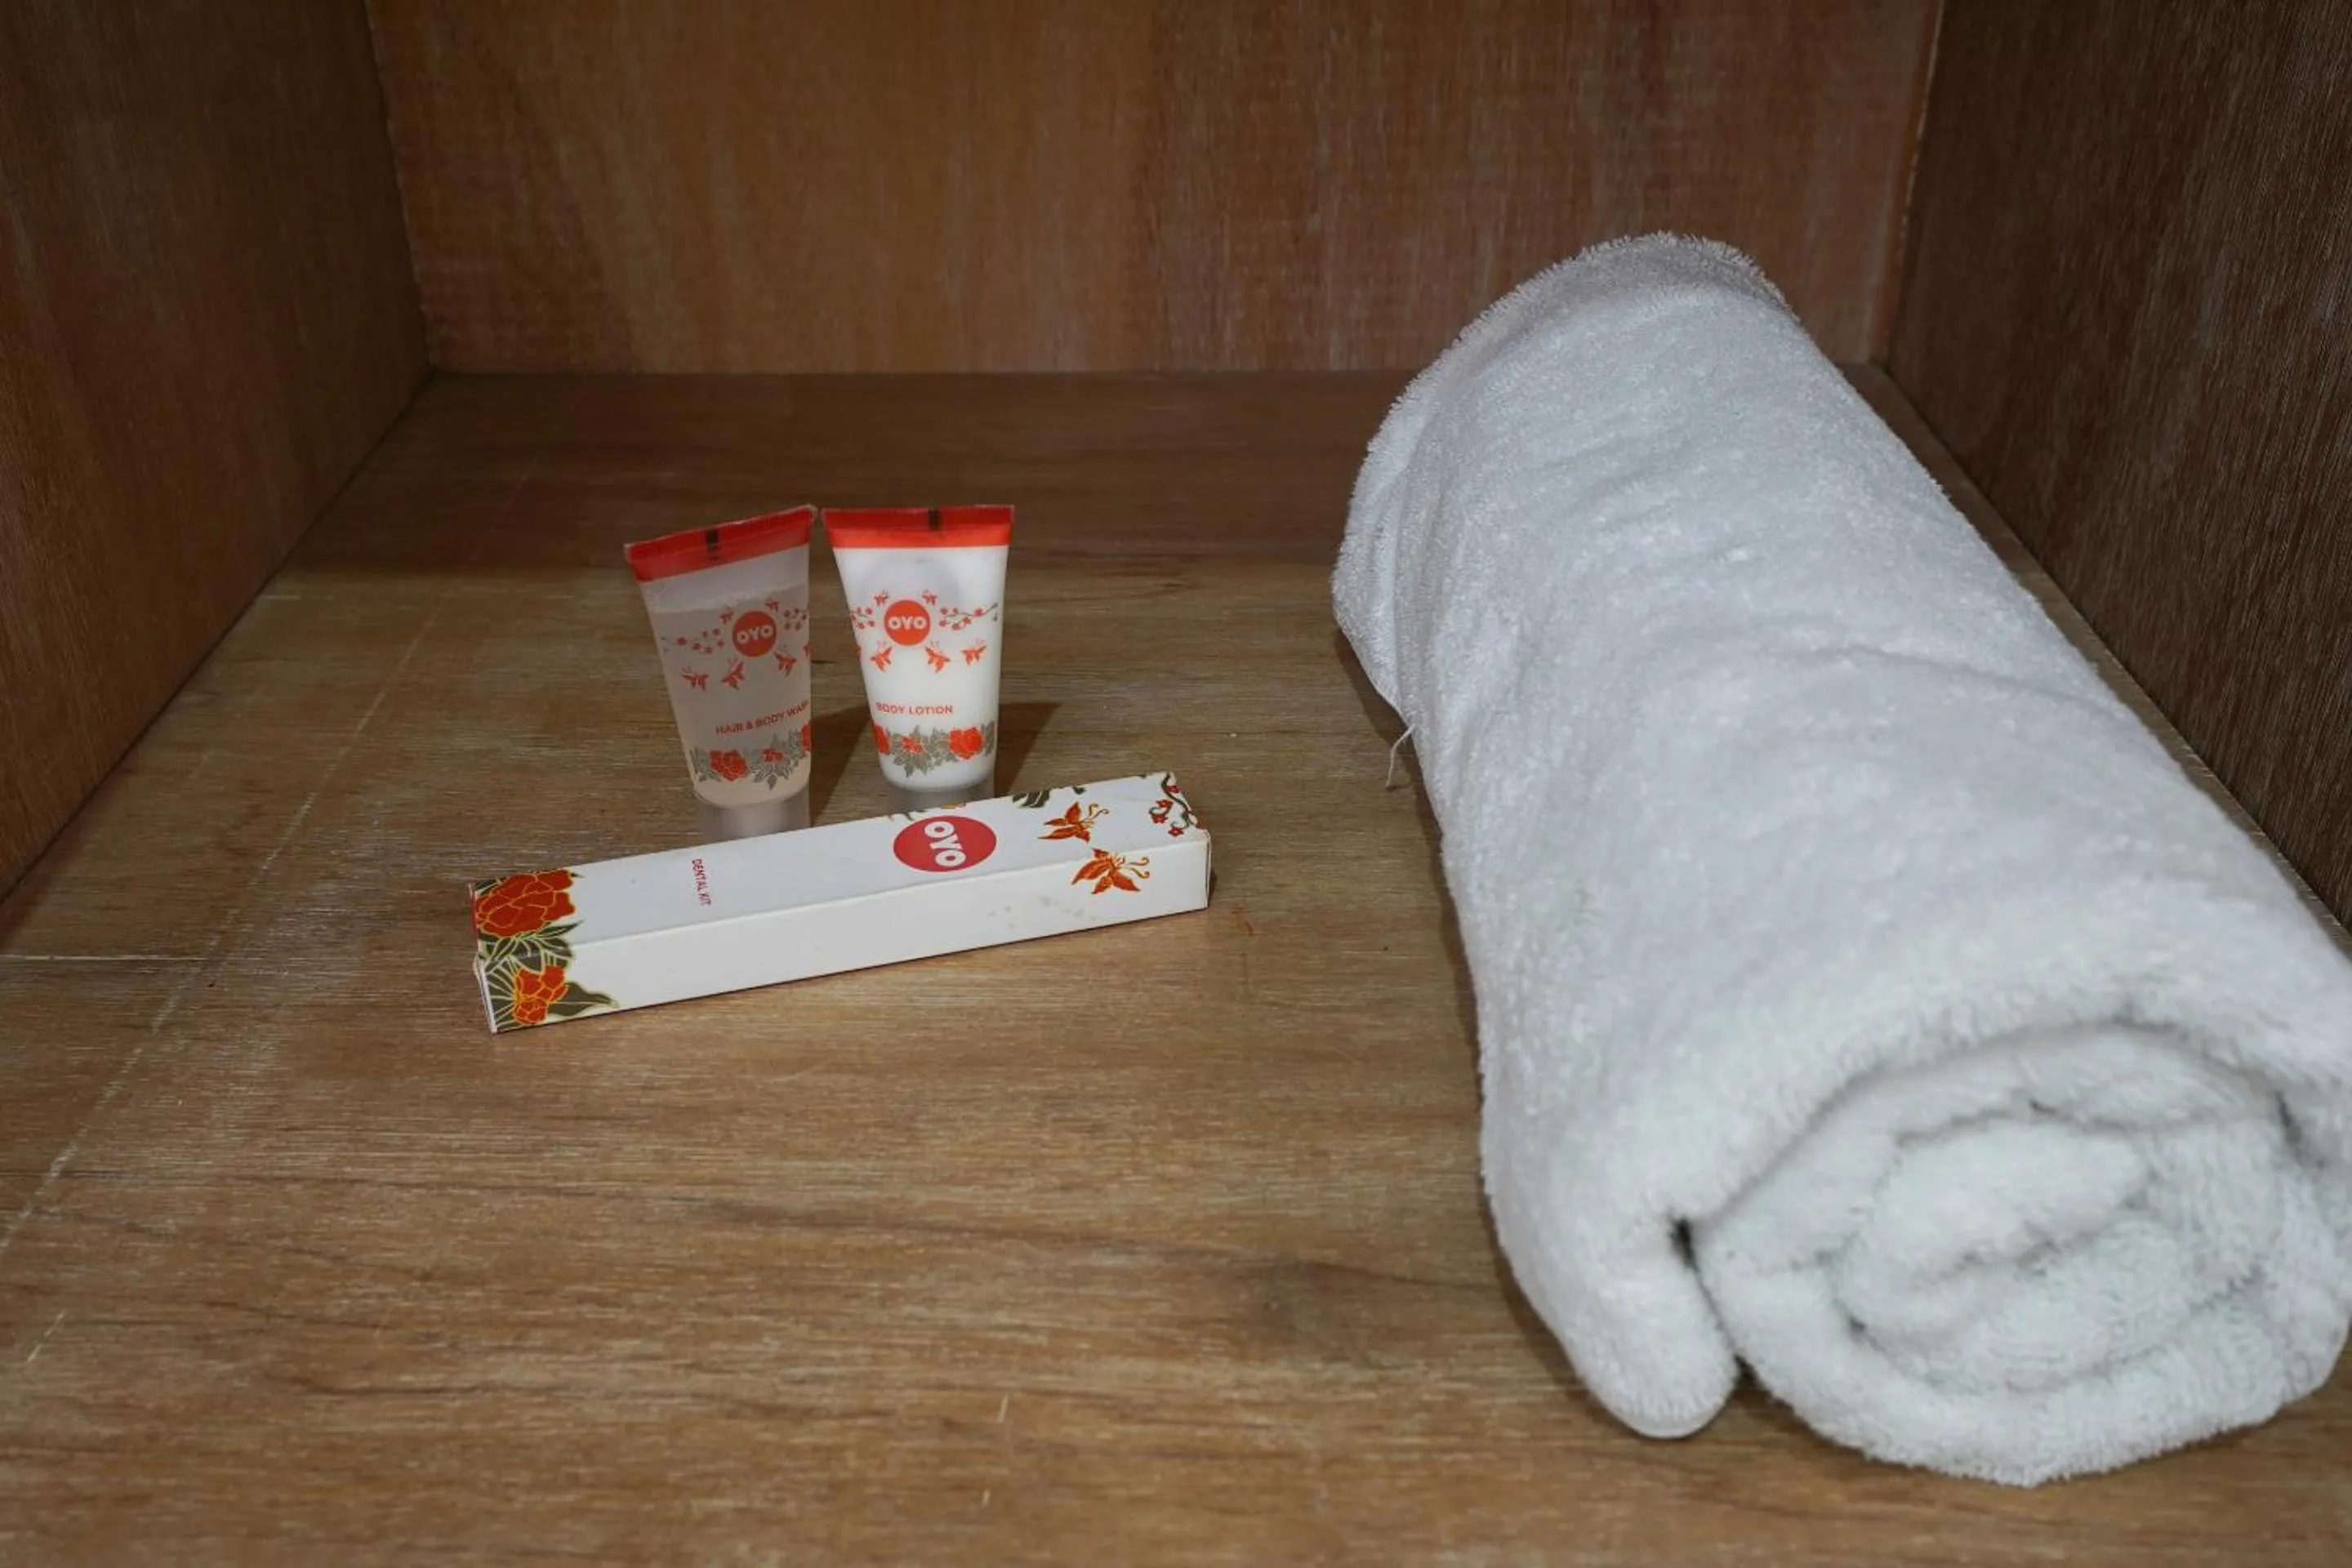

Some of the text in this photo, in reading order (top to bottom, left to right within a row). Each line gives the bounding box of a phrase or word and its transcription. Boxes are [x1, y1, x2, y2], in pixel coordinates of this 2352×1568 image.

[889, 615, 927, 630] OYO
[736, 625, 774, 644] OYO
[876, 702, 953, 715] BODY LOTION
[715, 723, 743, 734] HAIR
[755, 711, 785, 728] BODY
[924, 821, 966, 867] OYO
